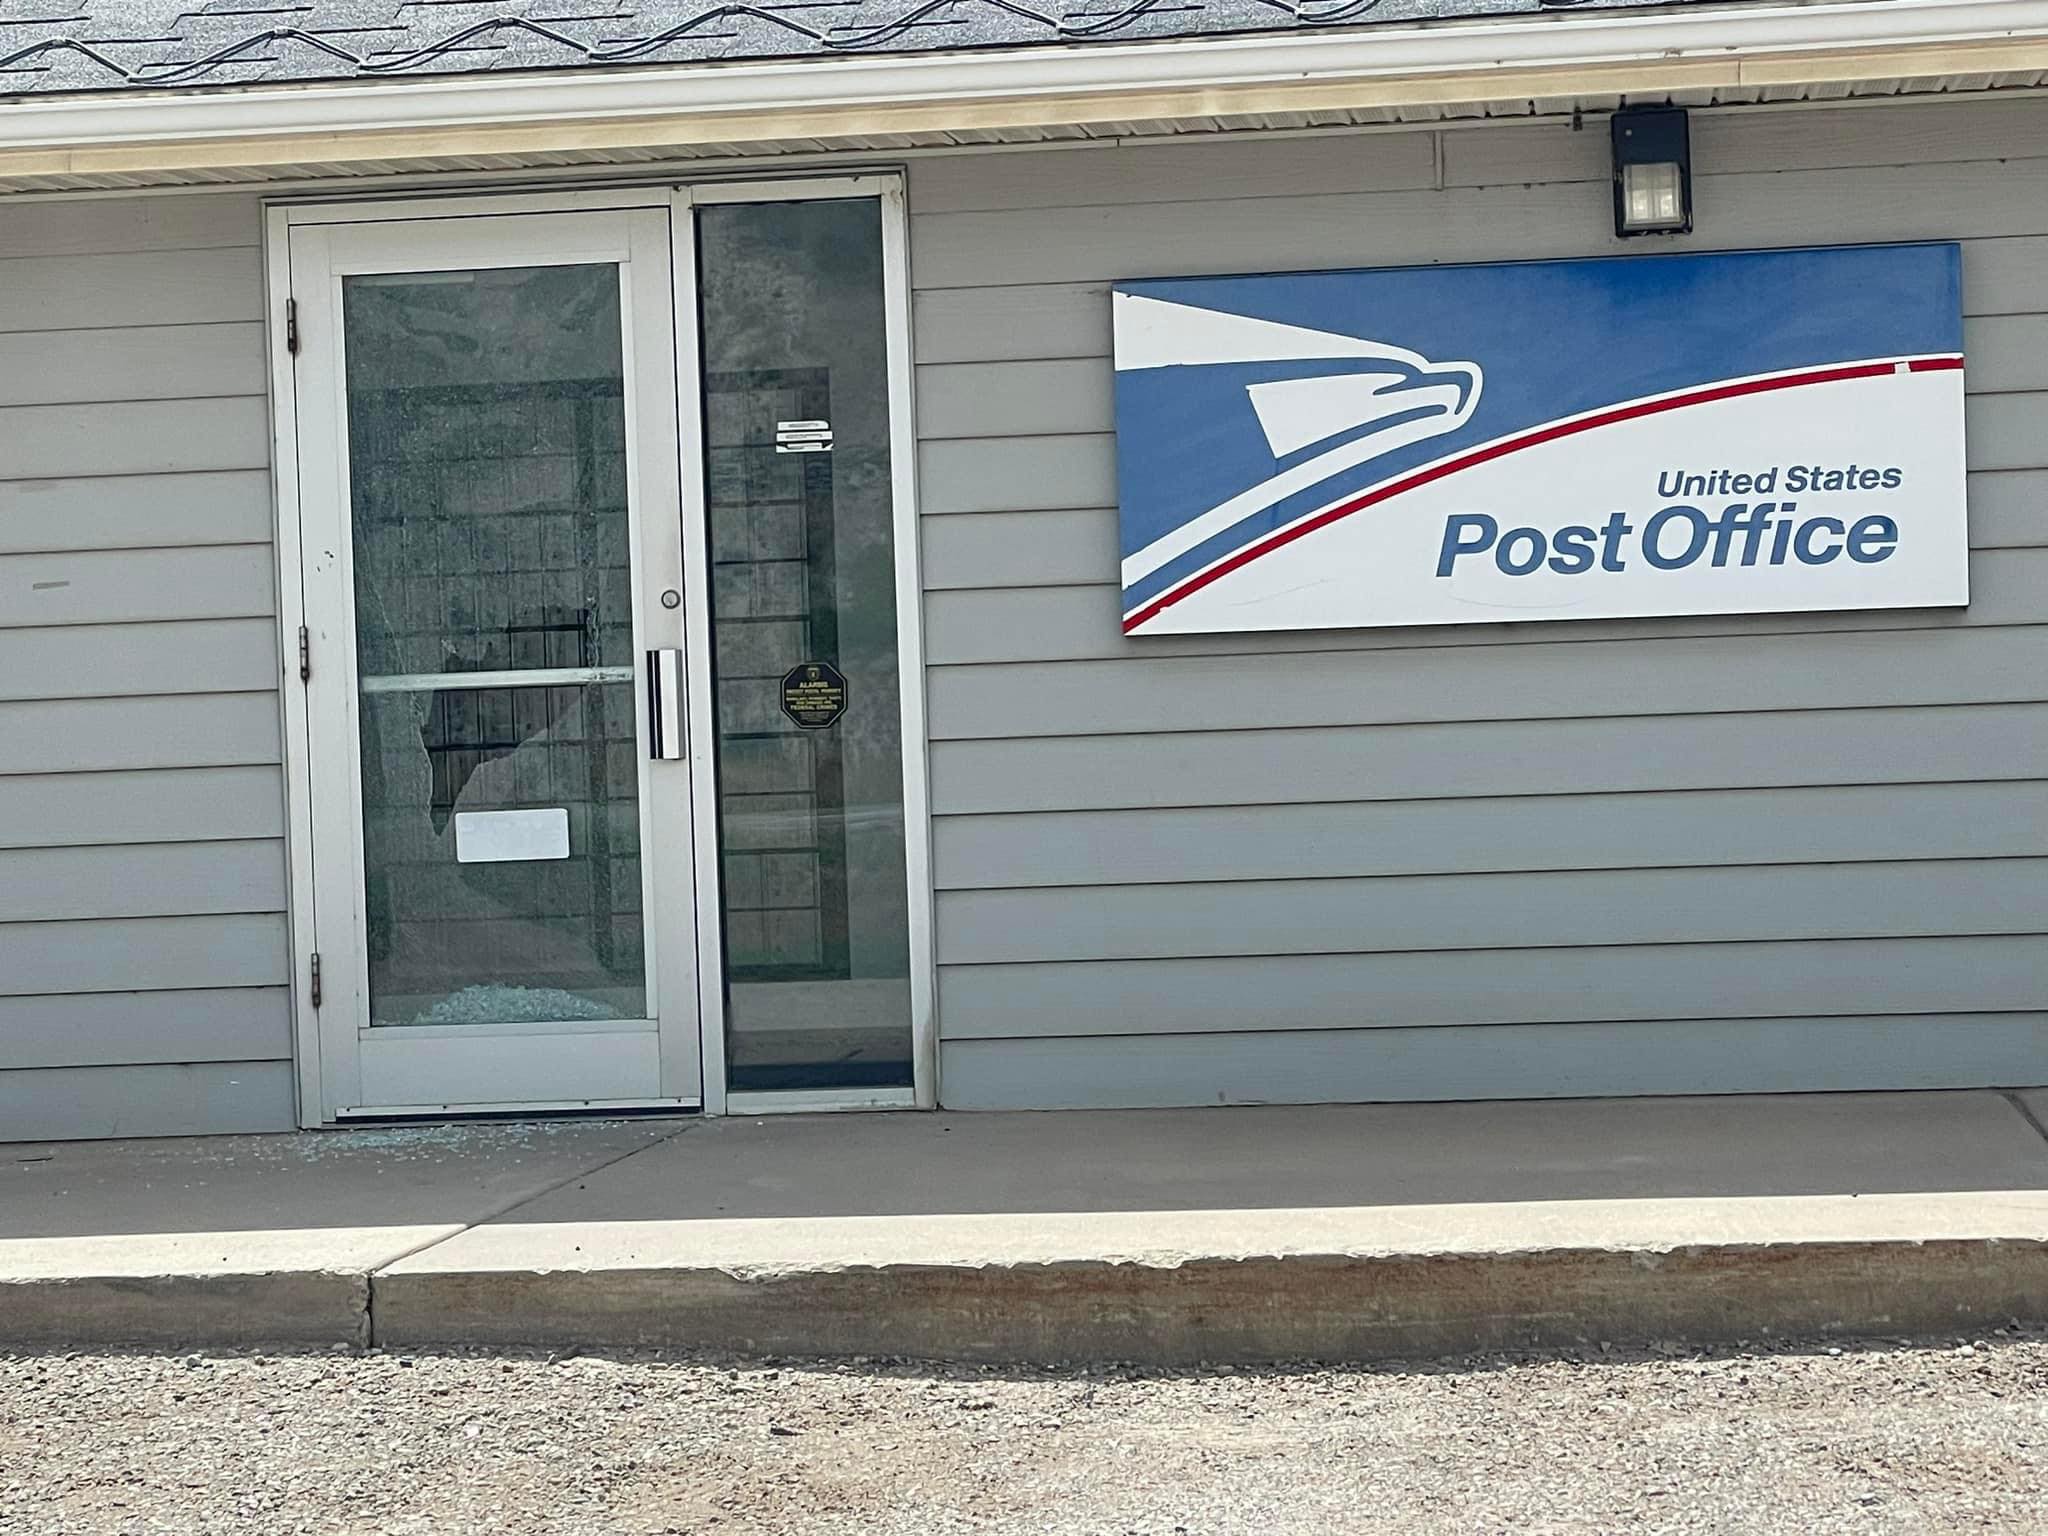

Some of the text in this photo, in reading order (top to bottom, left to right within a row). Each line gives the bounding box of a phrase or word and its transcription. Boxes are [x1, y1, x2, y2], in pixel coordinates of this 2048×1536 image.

[1657, 464, 1902, 497] United States
[1435, 502, 1899, 578] Post Office
